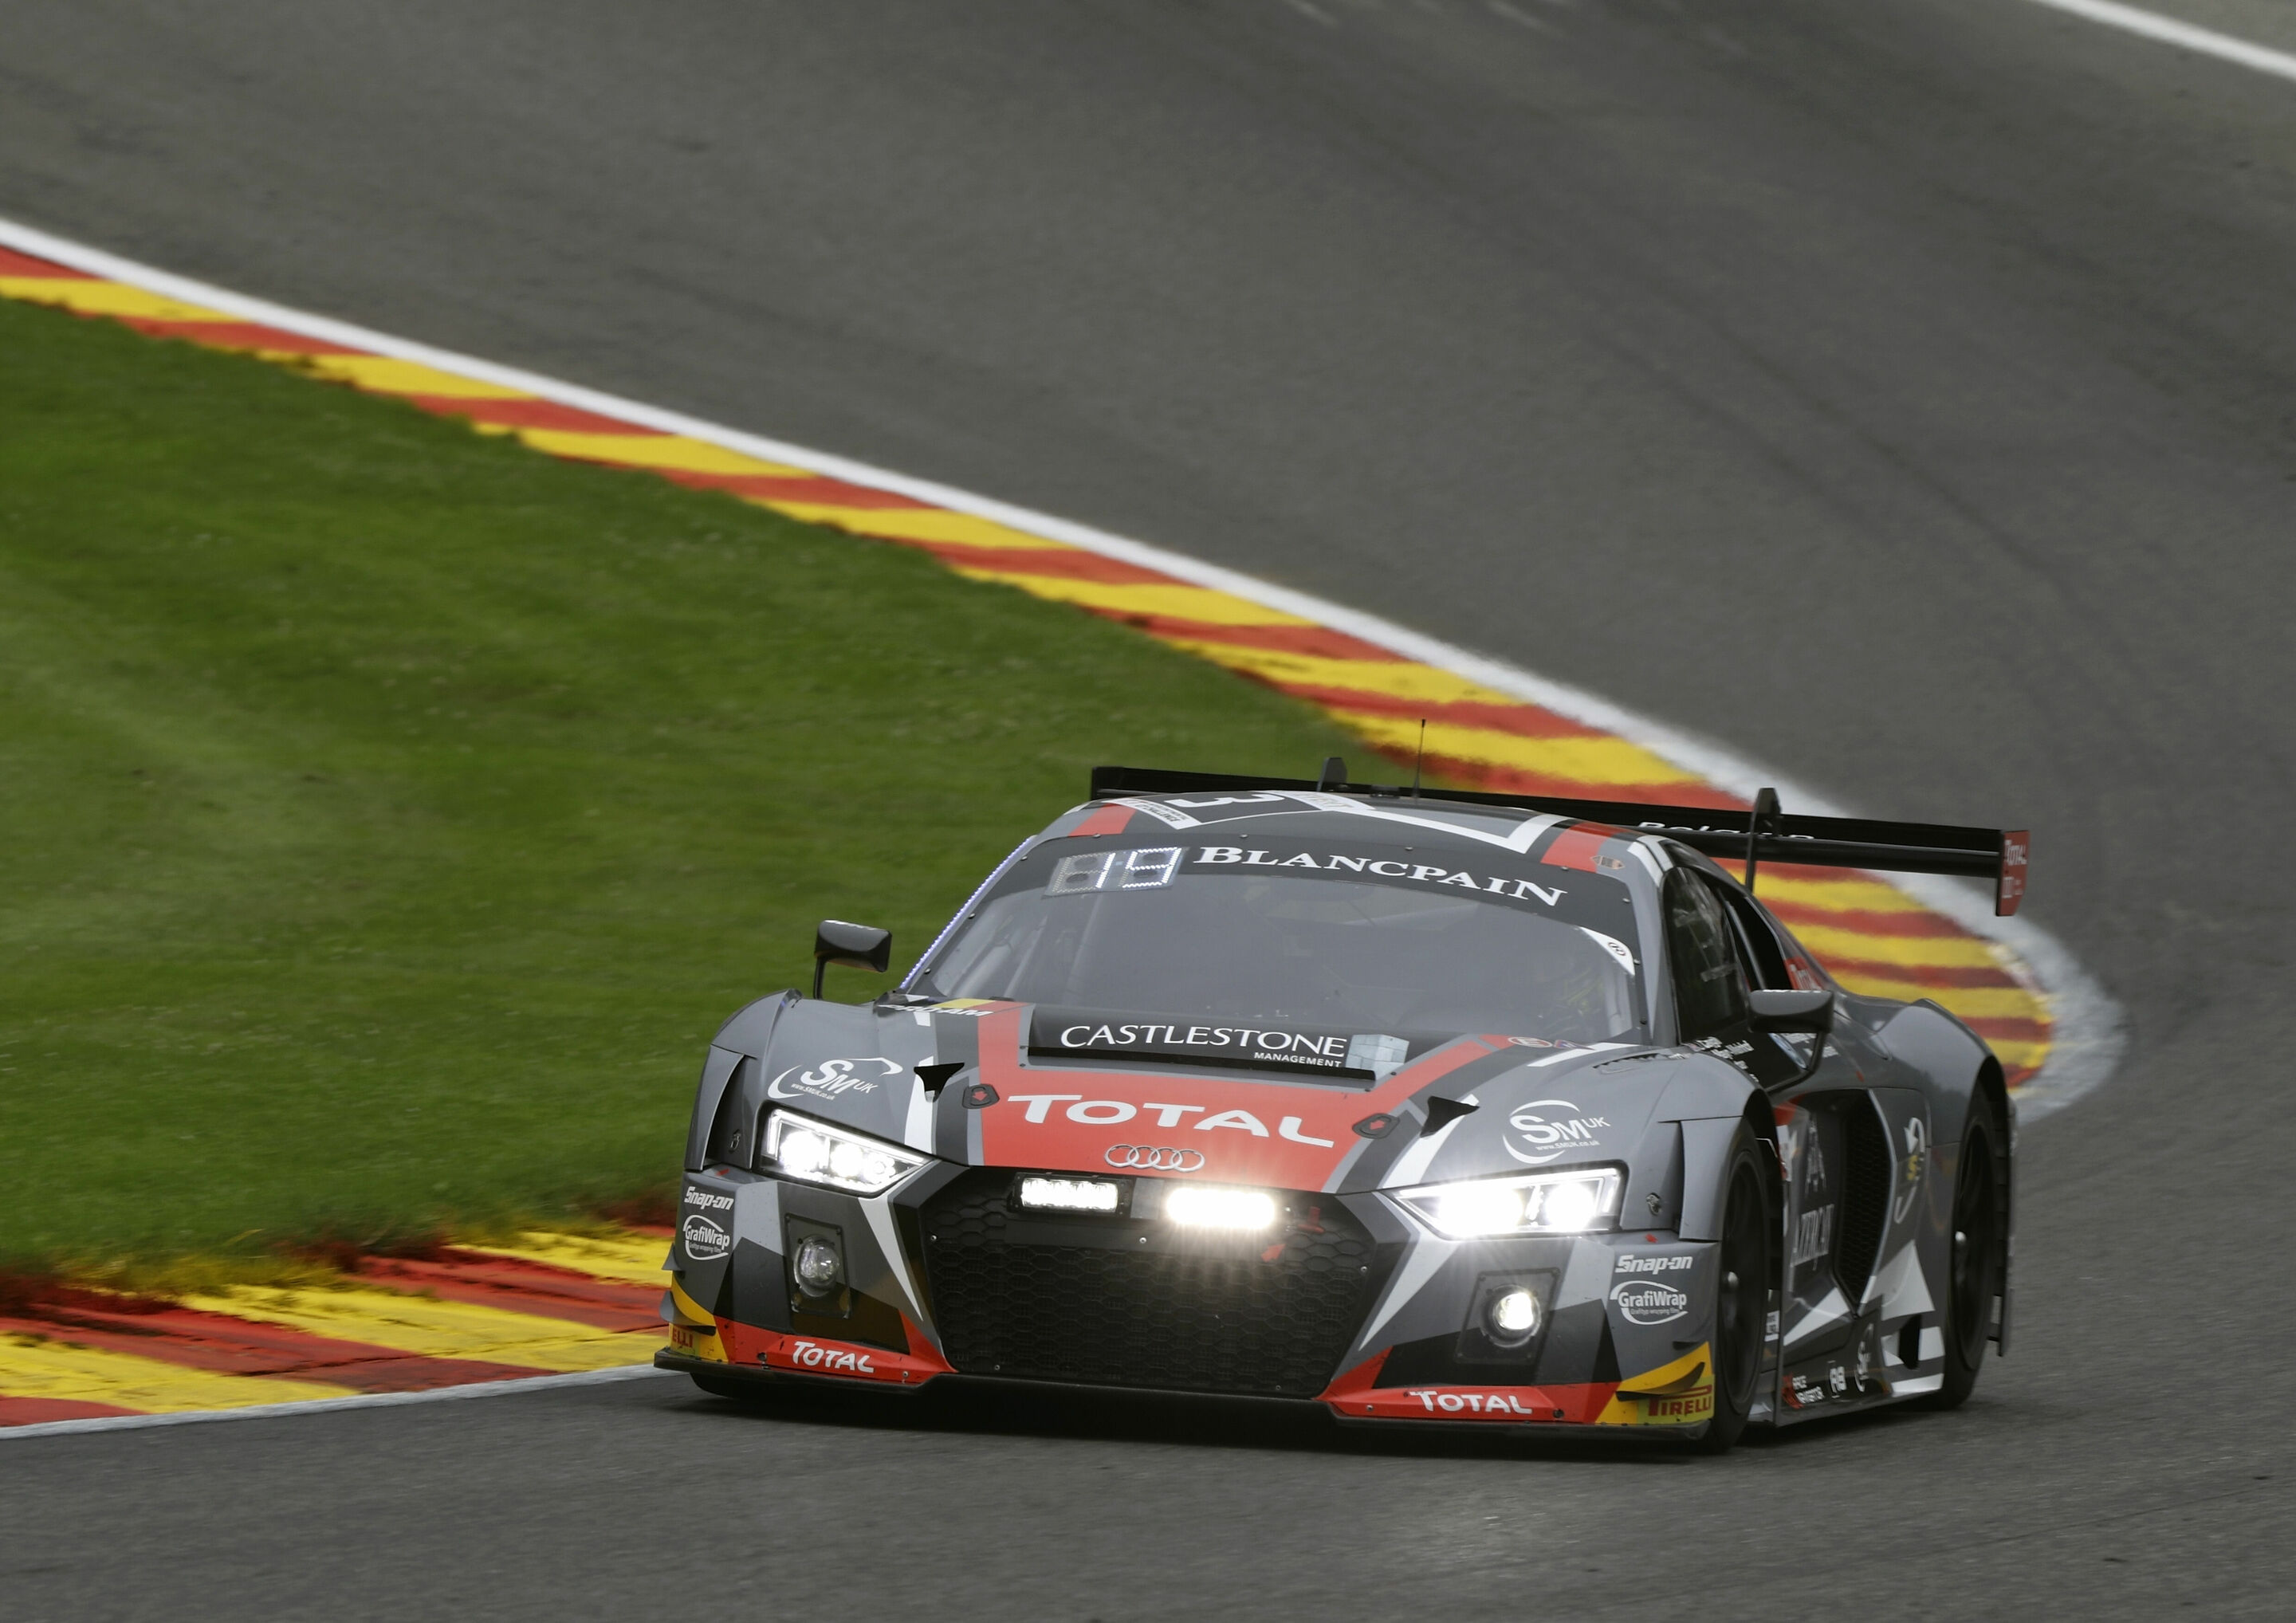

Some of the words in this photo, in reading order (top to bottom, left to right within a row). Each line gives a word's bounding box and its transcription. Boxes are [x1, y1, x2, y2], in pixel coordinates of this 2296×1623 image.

[1193, 847, 1567, 906] BLANCPAIN
[1060, 1024, 1348, 1058] CASTLESTONE
[1254, 1051, 1343, 1068] MANAGEMENT
[1008, 1094, 1335, 1149] TOTAL
[684, 1186, 734, 1210] Snap-on
[686, 1225, 730, 1251] GrafiWrap
[1614, 1255, 1693, 1275] Snap-on
[1618, 1291, 1687, 1310] GrafiWrap
[792, 1341, 875, 1373] TOTAL
[1409, 1390, 1533, 1414] TOTAL
